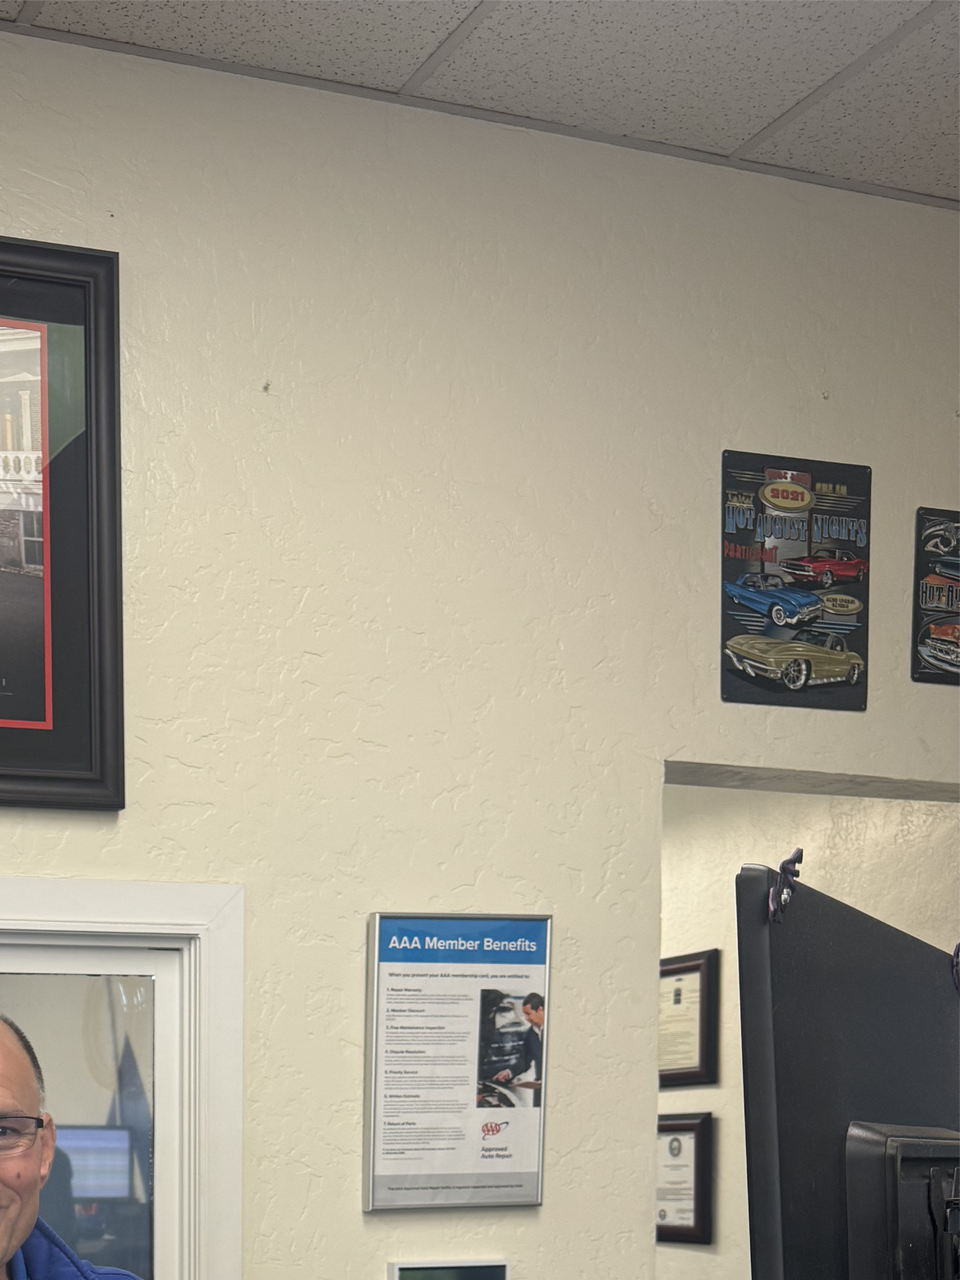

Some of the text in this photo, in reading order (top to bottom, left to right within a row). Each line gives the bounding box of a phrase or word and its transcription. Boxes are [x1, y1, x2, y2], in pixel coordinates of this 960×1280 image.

[770, 488, 805, 502] 2021
[725, 504, 867, 548] HOT AUGUST NIGHTS
[723, 540, 779, 563] PARTICIPANT
[388, 935, 537, 952] AAA Member Benefits
[482, 1122, 500, 1135] AAA
